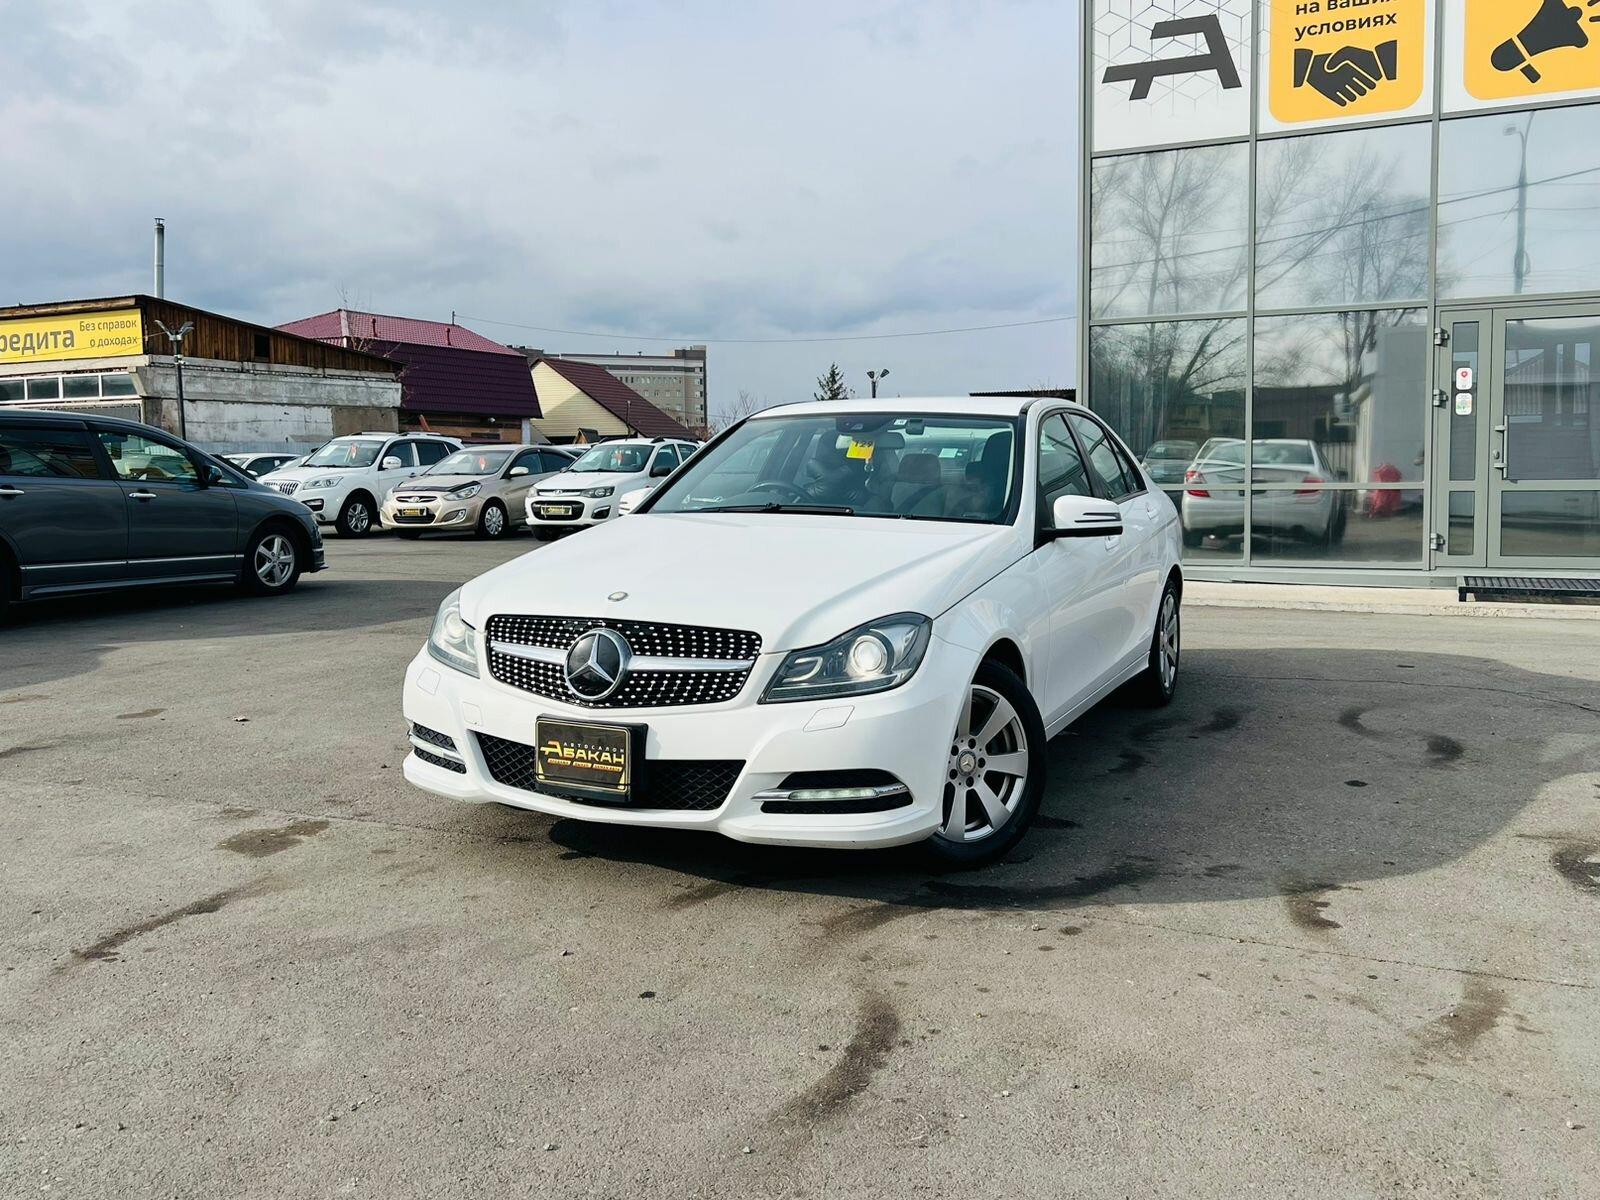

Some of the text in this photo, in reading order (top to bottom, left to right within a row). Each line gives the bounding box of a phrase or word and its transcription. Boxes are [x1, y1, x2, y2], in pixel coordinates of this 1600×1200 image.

[1296, 1, 1320, 15] на
[1294, 13, 1397, 41] условиях
[79, 320, 137, 332] Без справок
[90, 337, 138, 348] о доходах
[563, 742, 624, 753] АВТОСАЛОН
